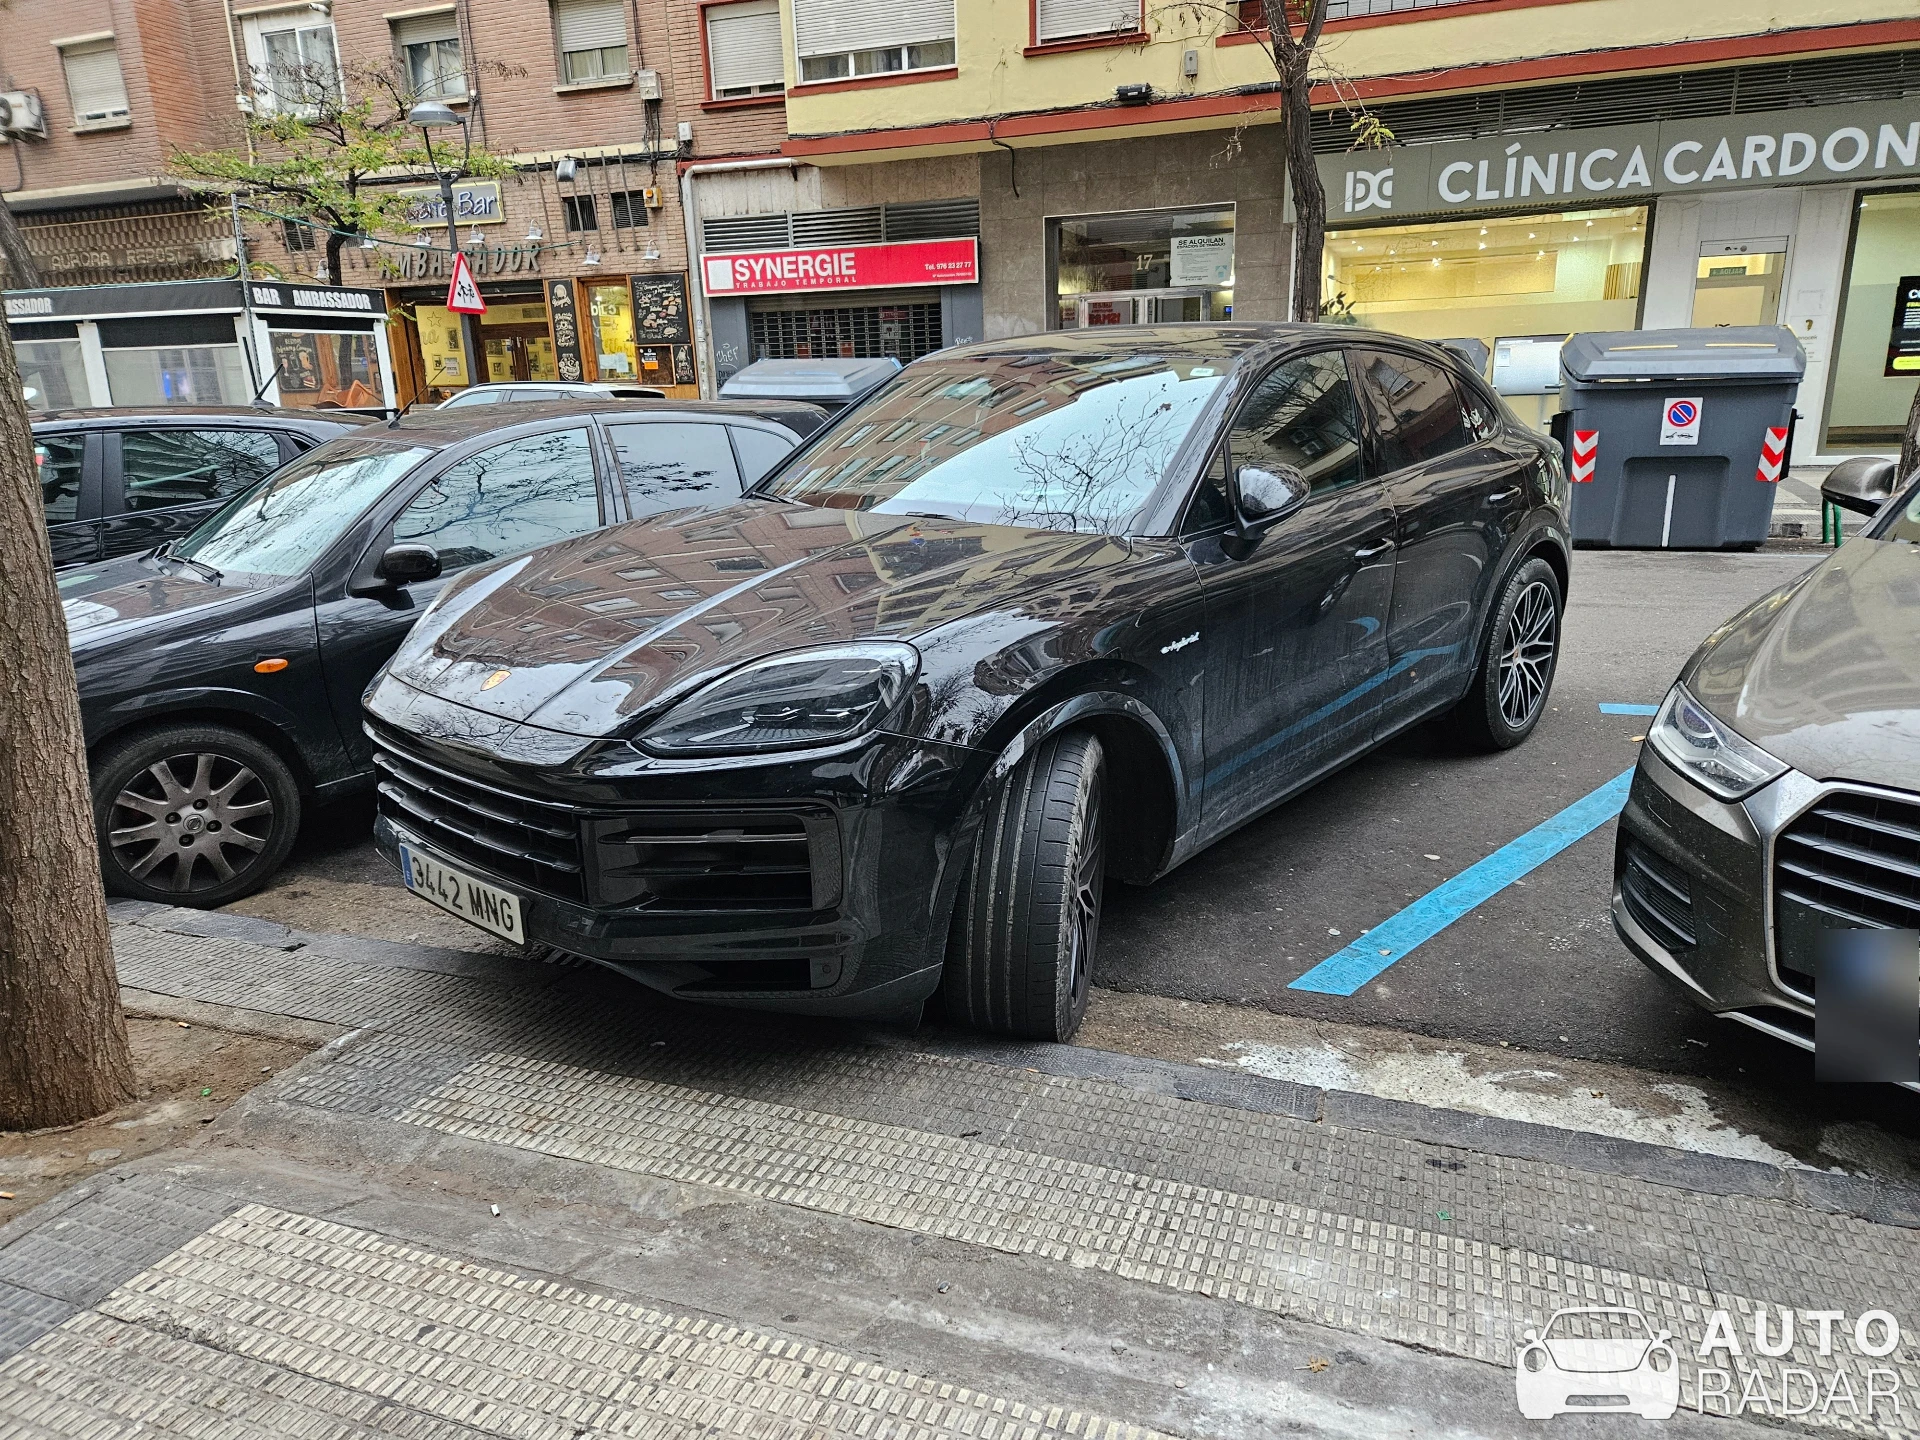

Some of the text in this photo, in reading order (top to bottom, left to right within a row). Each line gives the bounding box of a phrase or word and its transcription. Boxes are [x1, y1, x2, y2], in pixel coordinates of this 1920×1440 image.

[1438, 143, 1652, 203] CLÍNICA
[458, 191, 497, 216] Bar
[1189, 237, 1224, 246] ALQUILAN
[51, 251, 111, 271] AURORA
[734, 252, 856, 282] SYNERGIE
[936, 262, 947, 270] 976
[1136, 254, 1153, 271] 17
[736, 277, 857, 289] TRABAJO TEMPORAL
[252, 287, 372, 310] BAR AMBASSADOR
[412, 856, 514, 932] 3442 MNG
